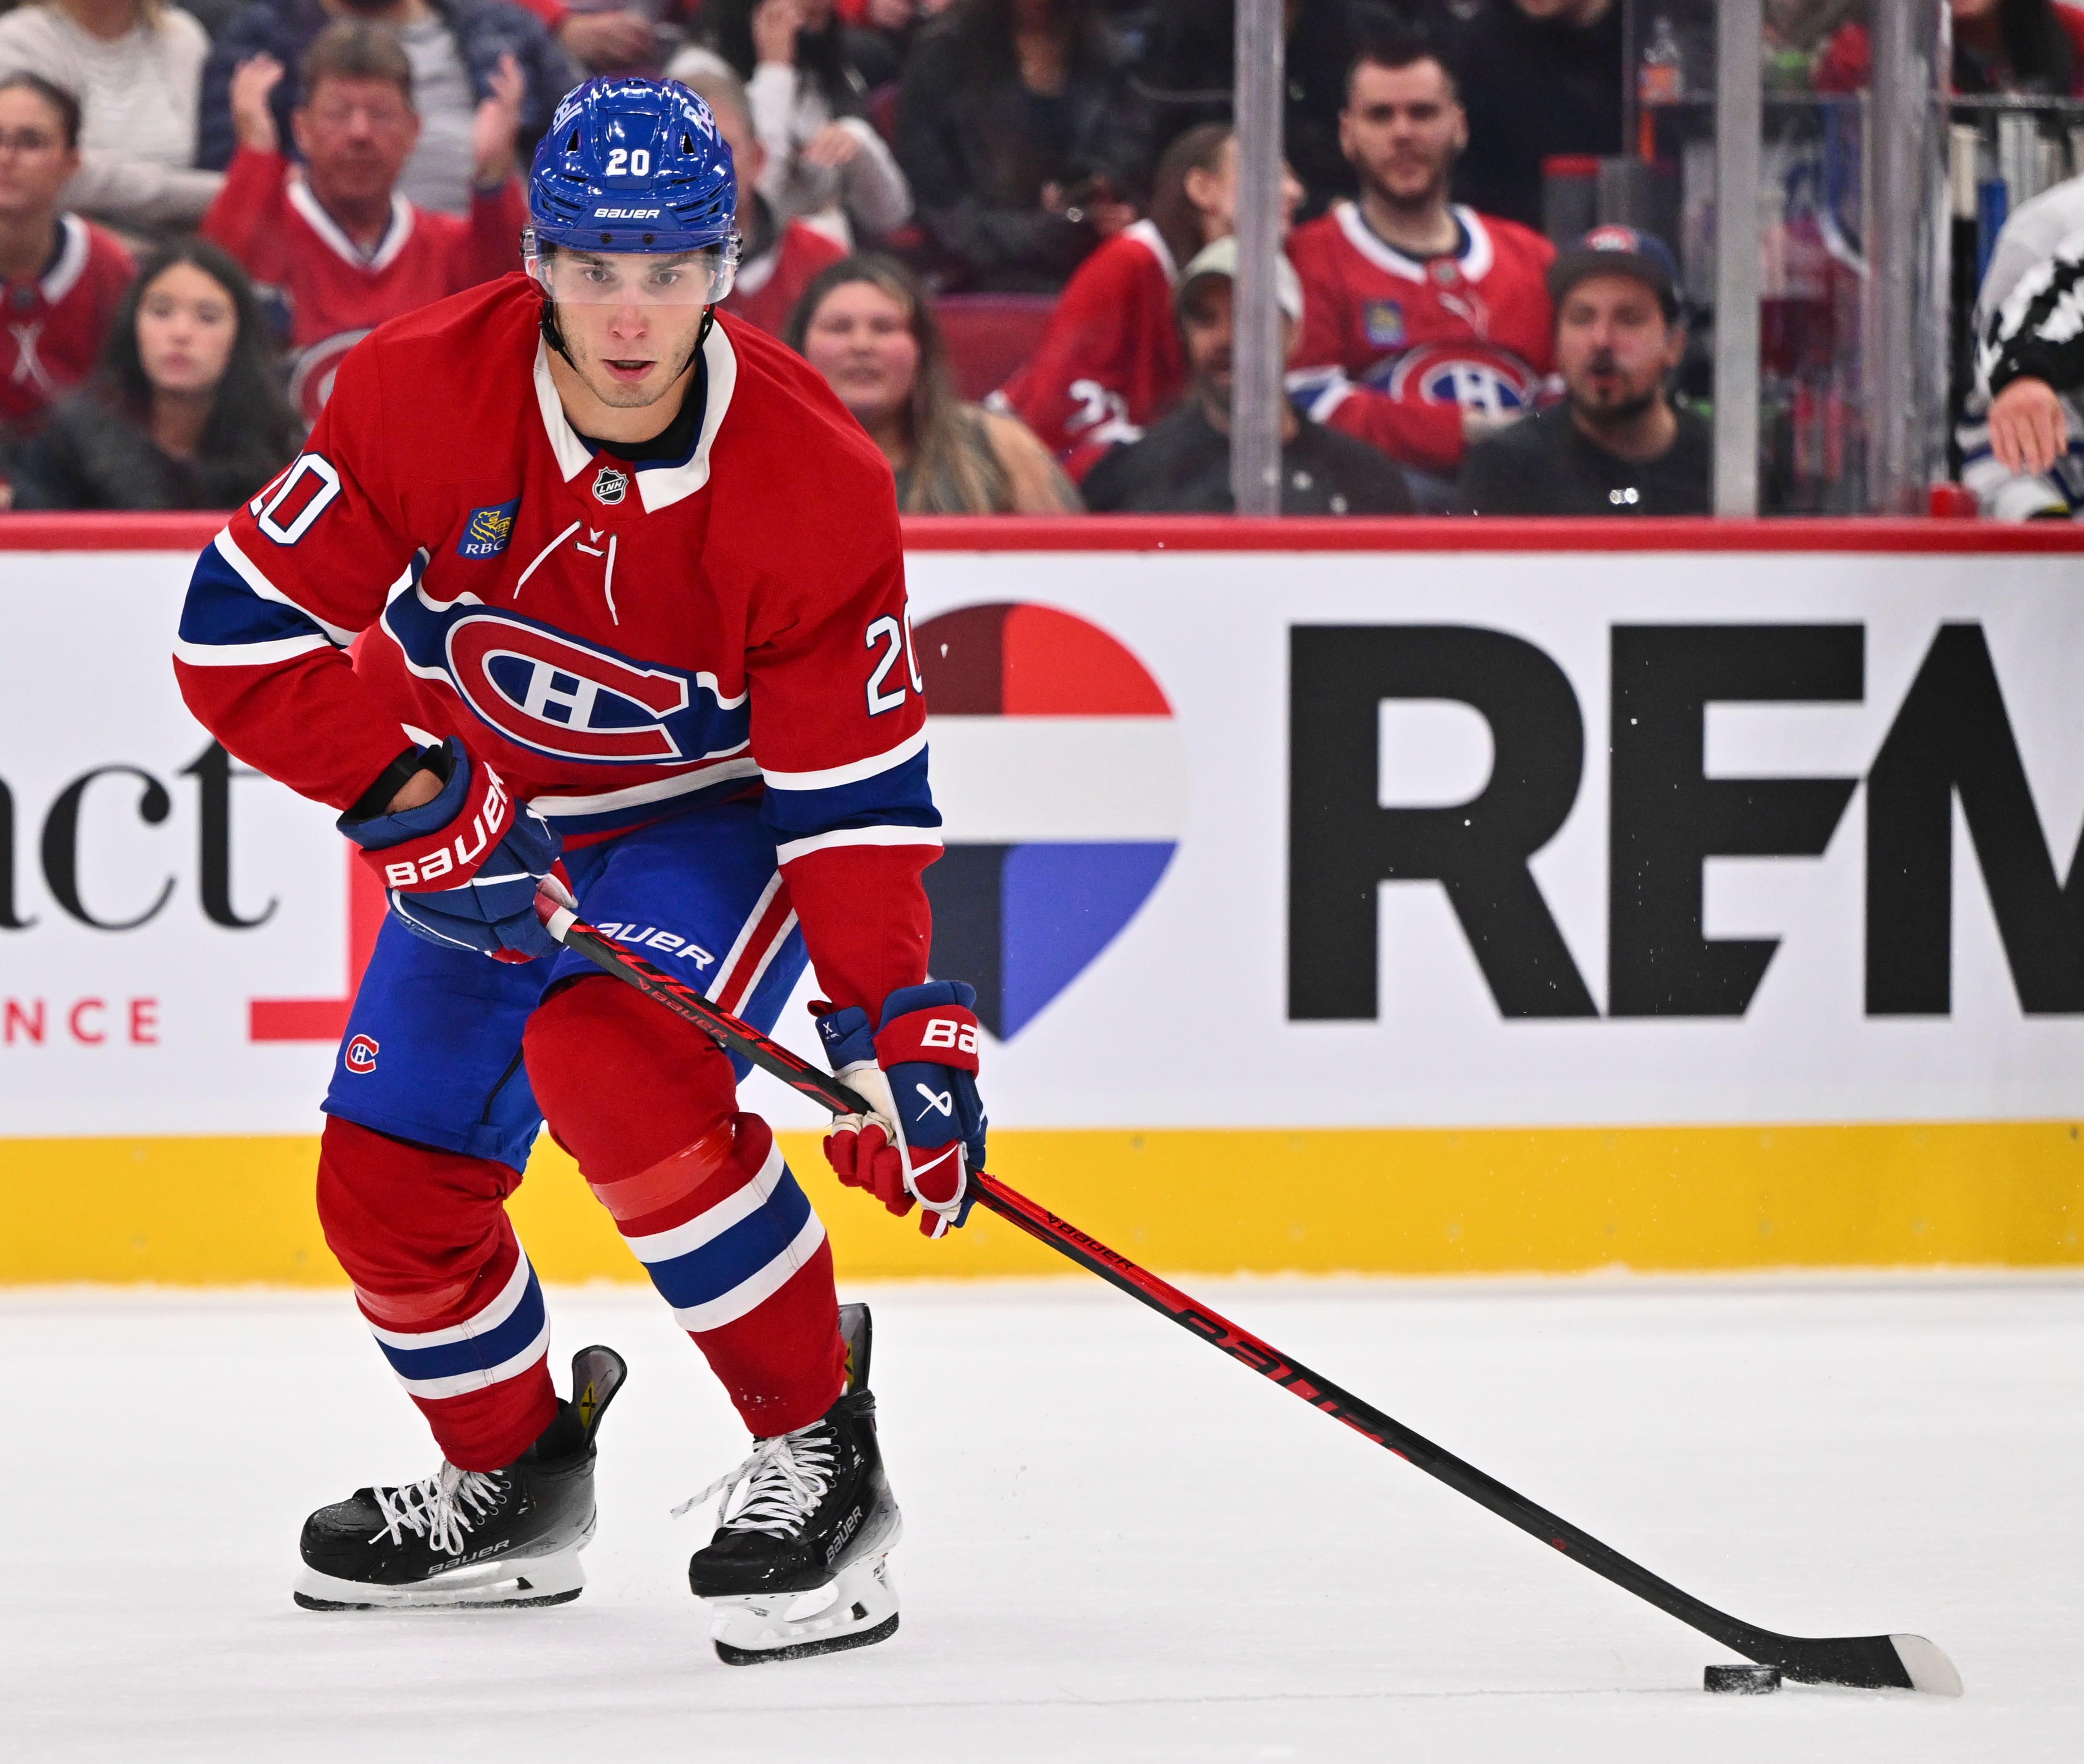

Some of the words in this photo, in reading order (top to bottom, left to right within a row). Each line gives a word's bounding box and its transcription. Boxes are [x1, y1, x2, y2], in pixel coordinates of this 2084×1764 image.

[606, 148, 650, 176] 20
[599, 480, 623, 494] LNH
[465, 539, 505, 554] RBC
[0, 739, 279, 932] ct
[584, 922, 715, 972] AUER
[3, 998, 160, 1046] NCE
